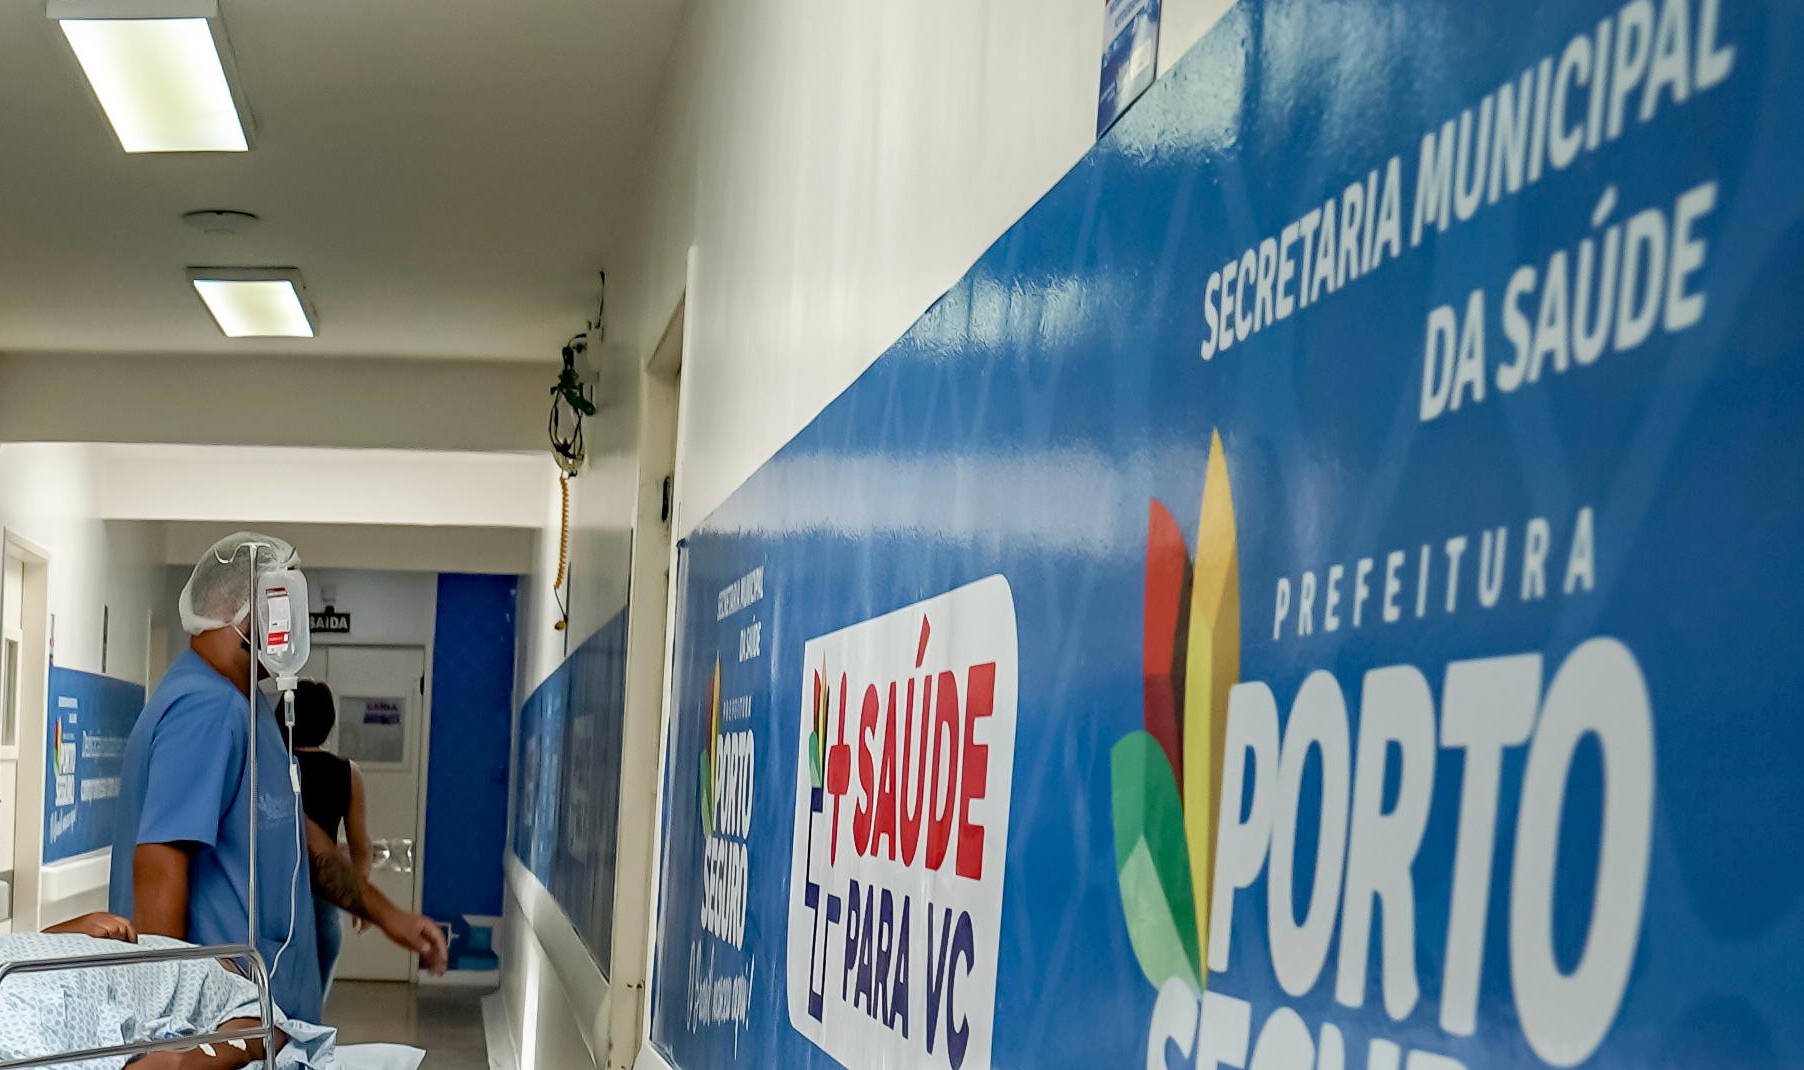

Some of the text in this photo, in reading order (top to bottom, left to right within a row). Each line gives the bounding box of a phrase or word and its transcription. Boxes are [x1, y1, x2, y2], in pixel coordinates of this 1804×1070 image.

[1200, 0, 1737, 362] SECRETARIA MUNICIPAL
[1419, 180, 1717, 422] DA SAÚDE
[1272, 506, 1595, 641] PREFEITURA
[713, 729, 755, 840] PORTO
[851, 613, 997, 881] SAÚDE
[701, 834, 748, 951] SEGURO
[1206, 636, 1656, 1068] PORTO
[843, 878, 909, 1040] PARA
